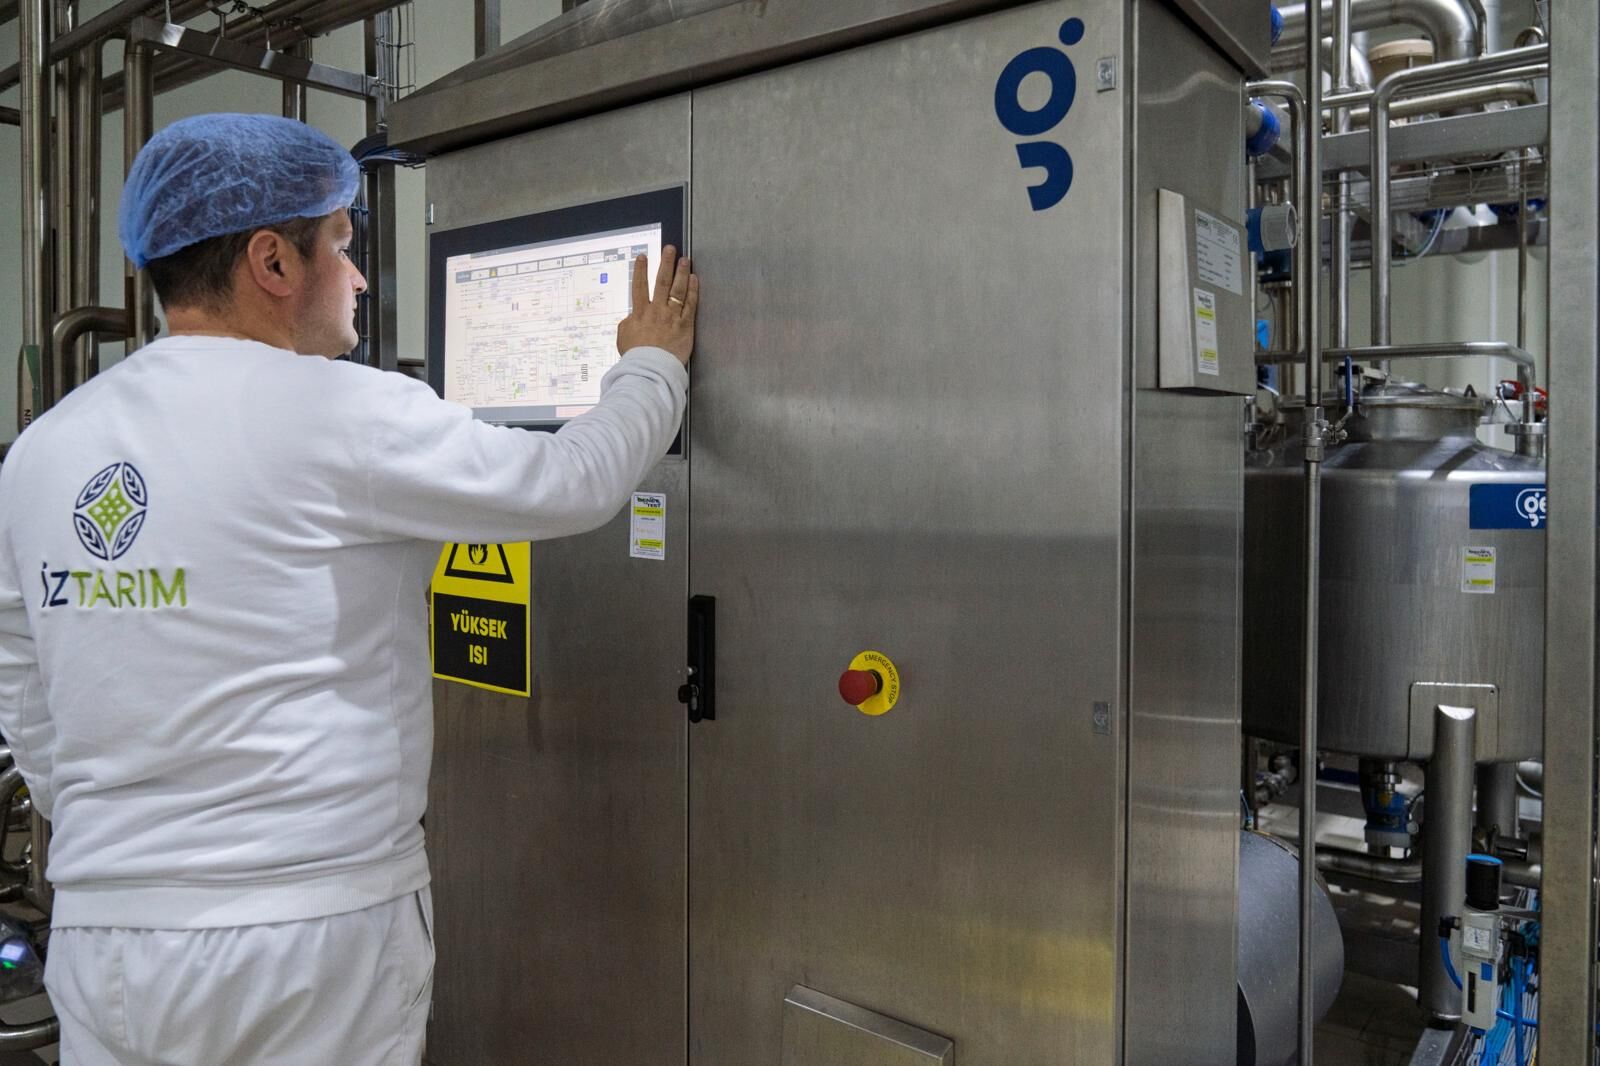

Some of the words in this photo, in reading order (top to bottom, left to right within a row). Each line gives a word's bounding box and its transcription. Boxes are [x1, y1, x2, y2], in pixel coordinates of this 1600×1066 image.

[450, 609, 508, 640] YÜKSEK
[469, 644, 488, 666] ISI
[864, 654, 897, 683] EMERGENCY
[888, 684, 897, 704] STOP
